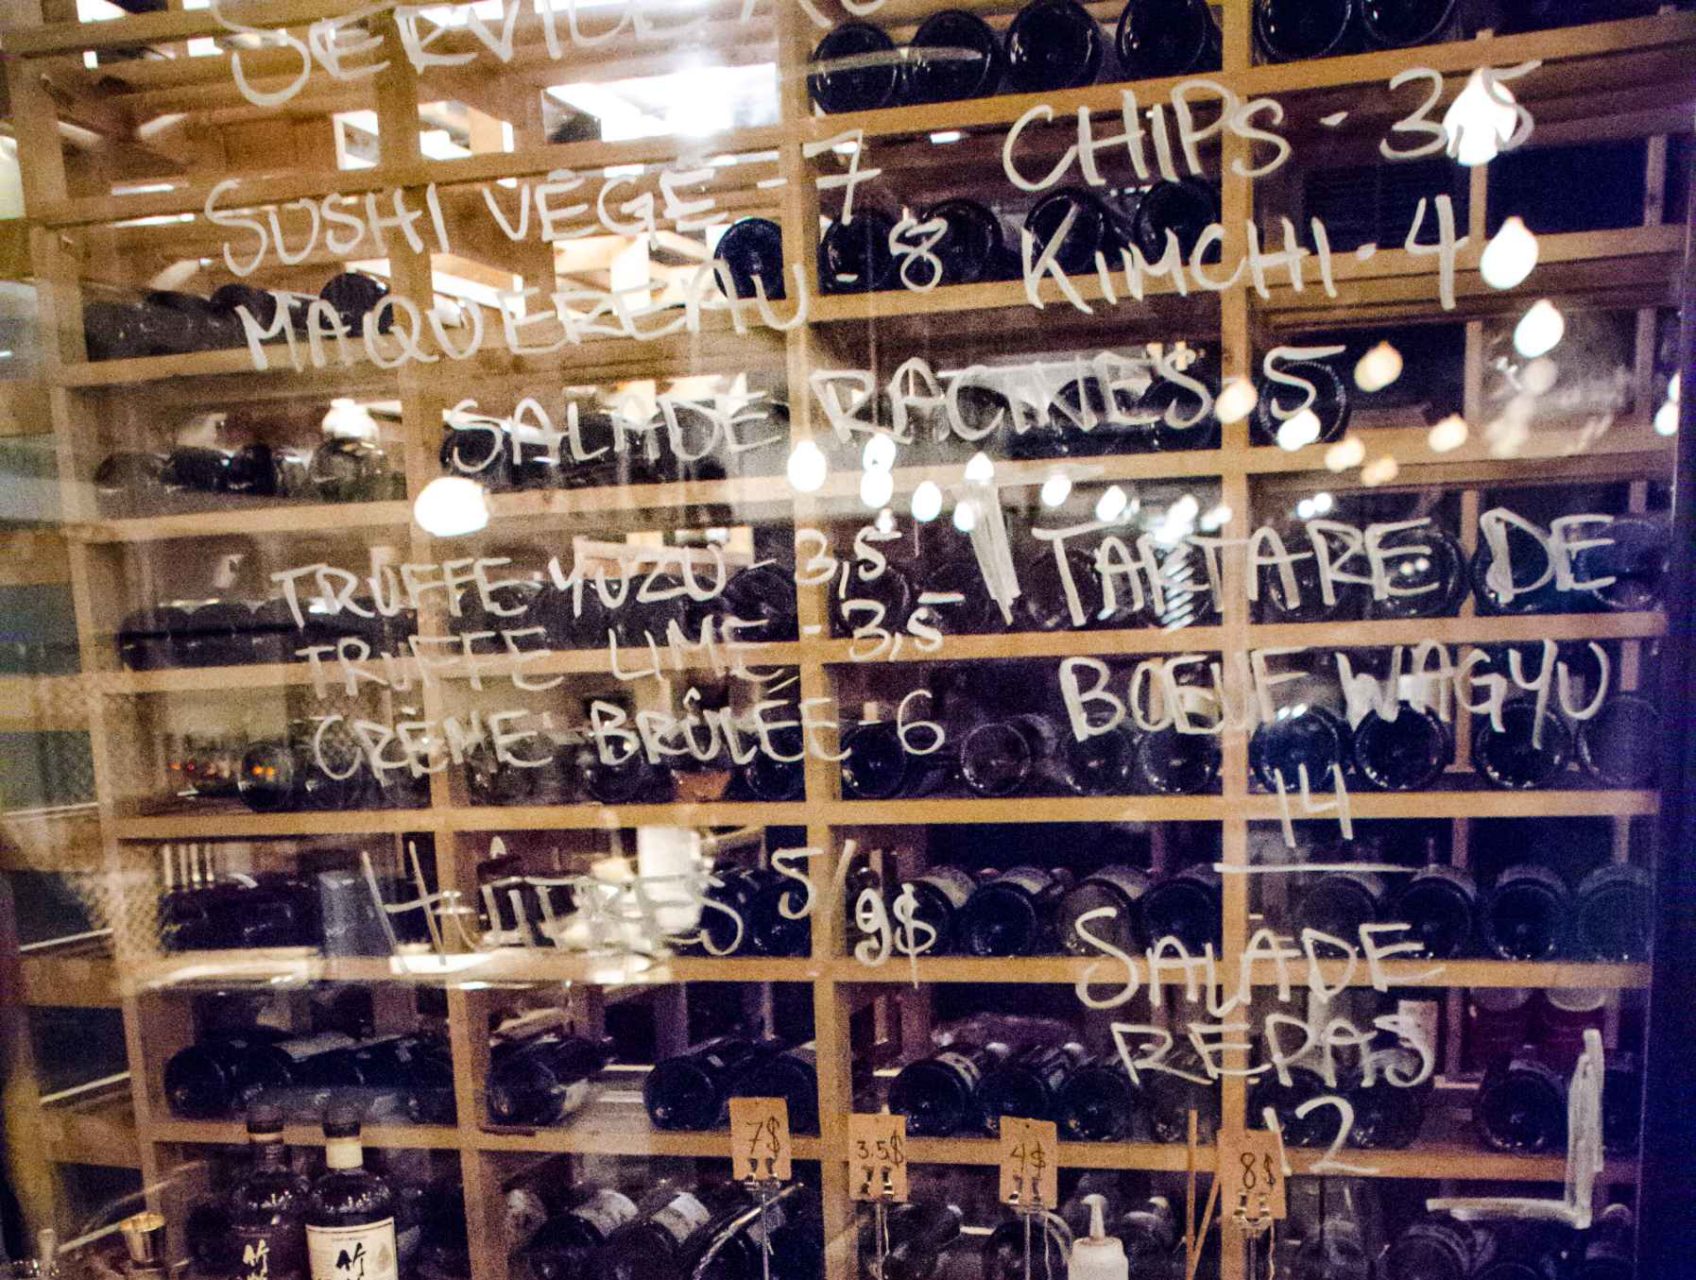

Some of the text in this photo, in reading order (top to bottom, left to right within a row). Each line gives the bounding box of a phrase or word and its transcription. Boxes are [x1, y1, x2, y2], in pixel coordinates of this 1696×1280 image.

[1003, 80, 1292, 190] CHIPS
[204, 179, 449, 277] SUSHI
[802, 129, 882, 226] 7
[1022, 203, 1337, 313] KIMCHI
[1404, 194, 1470, 311] 4
[234, 257, 807, 373] MAQUEREAU
[889, 217, 948, 292] 8
[446, 345, 1346, 473] SALADE RACINES 5
[273, 556, 542, 629] TRUFFE
[549, 537, 726, 618] YUZU
[795, 526, 902, 600] 3,5
[1031, 507, 1616, 627] TARTARE DE
[295, 626, 563, 699] TRUFFE
[608, 614, 784, 682] LIME
[842, 599, 944, 662] 3,5
[1335, 638, 1610, 750] WAGYU
[590, 675, 852, 765] BRÛLÉE
[898, 688, 946, 756] 6
[1274, 763, 1354, 848] 14
[1075, 906, 1447, 1017] SALADE
[1111, 1013, 1435, 1089] REPAS
[745, 1115, 782, 1160] 7$
[856, 1129, 905, 1169] 3.5$
[1009, 1140, 1047, 1178] 4$
[1239, 1151, 1277, 1191] 8$
[1262, 1096, 1380, 1177] 12
